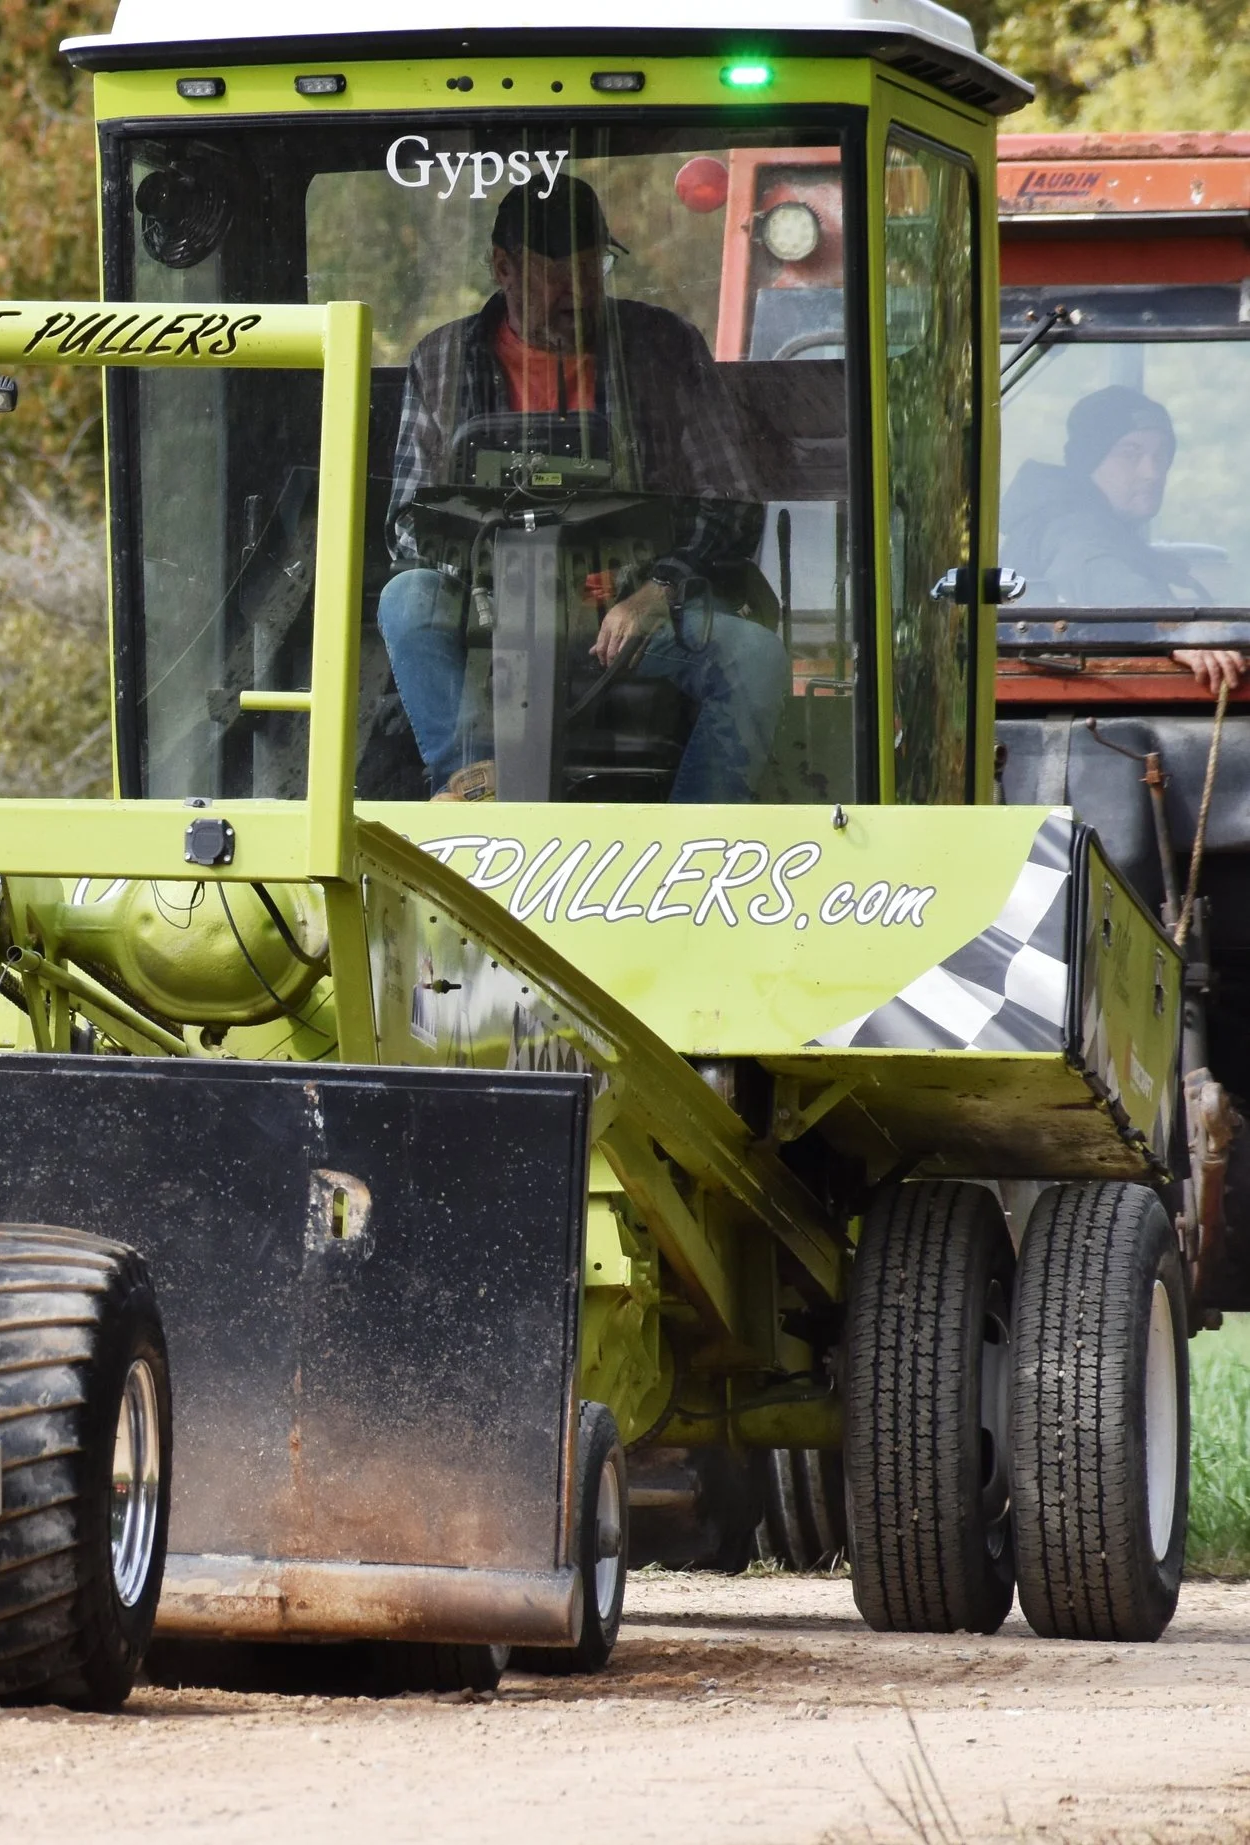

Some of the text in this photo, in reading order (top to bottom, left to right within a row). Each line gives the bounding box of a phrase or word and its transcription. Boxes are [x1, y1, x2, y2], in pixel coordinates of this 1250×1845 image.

[386, 135, 569, 199] Gypsy
[1016, 170, 1102, 196] LAURIN
[24, 311, 262, 355] PULLERS
